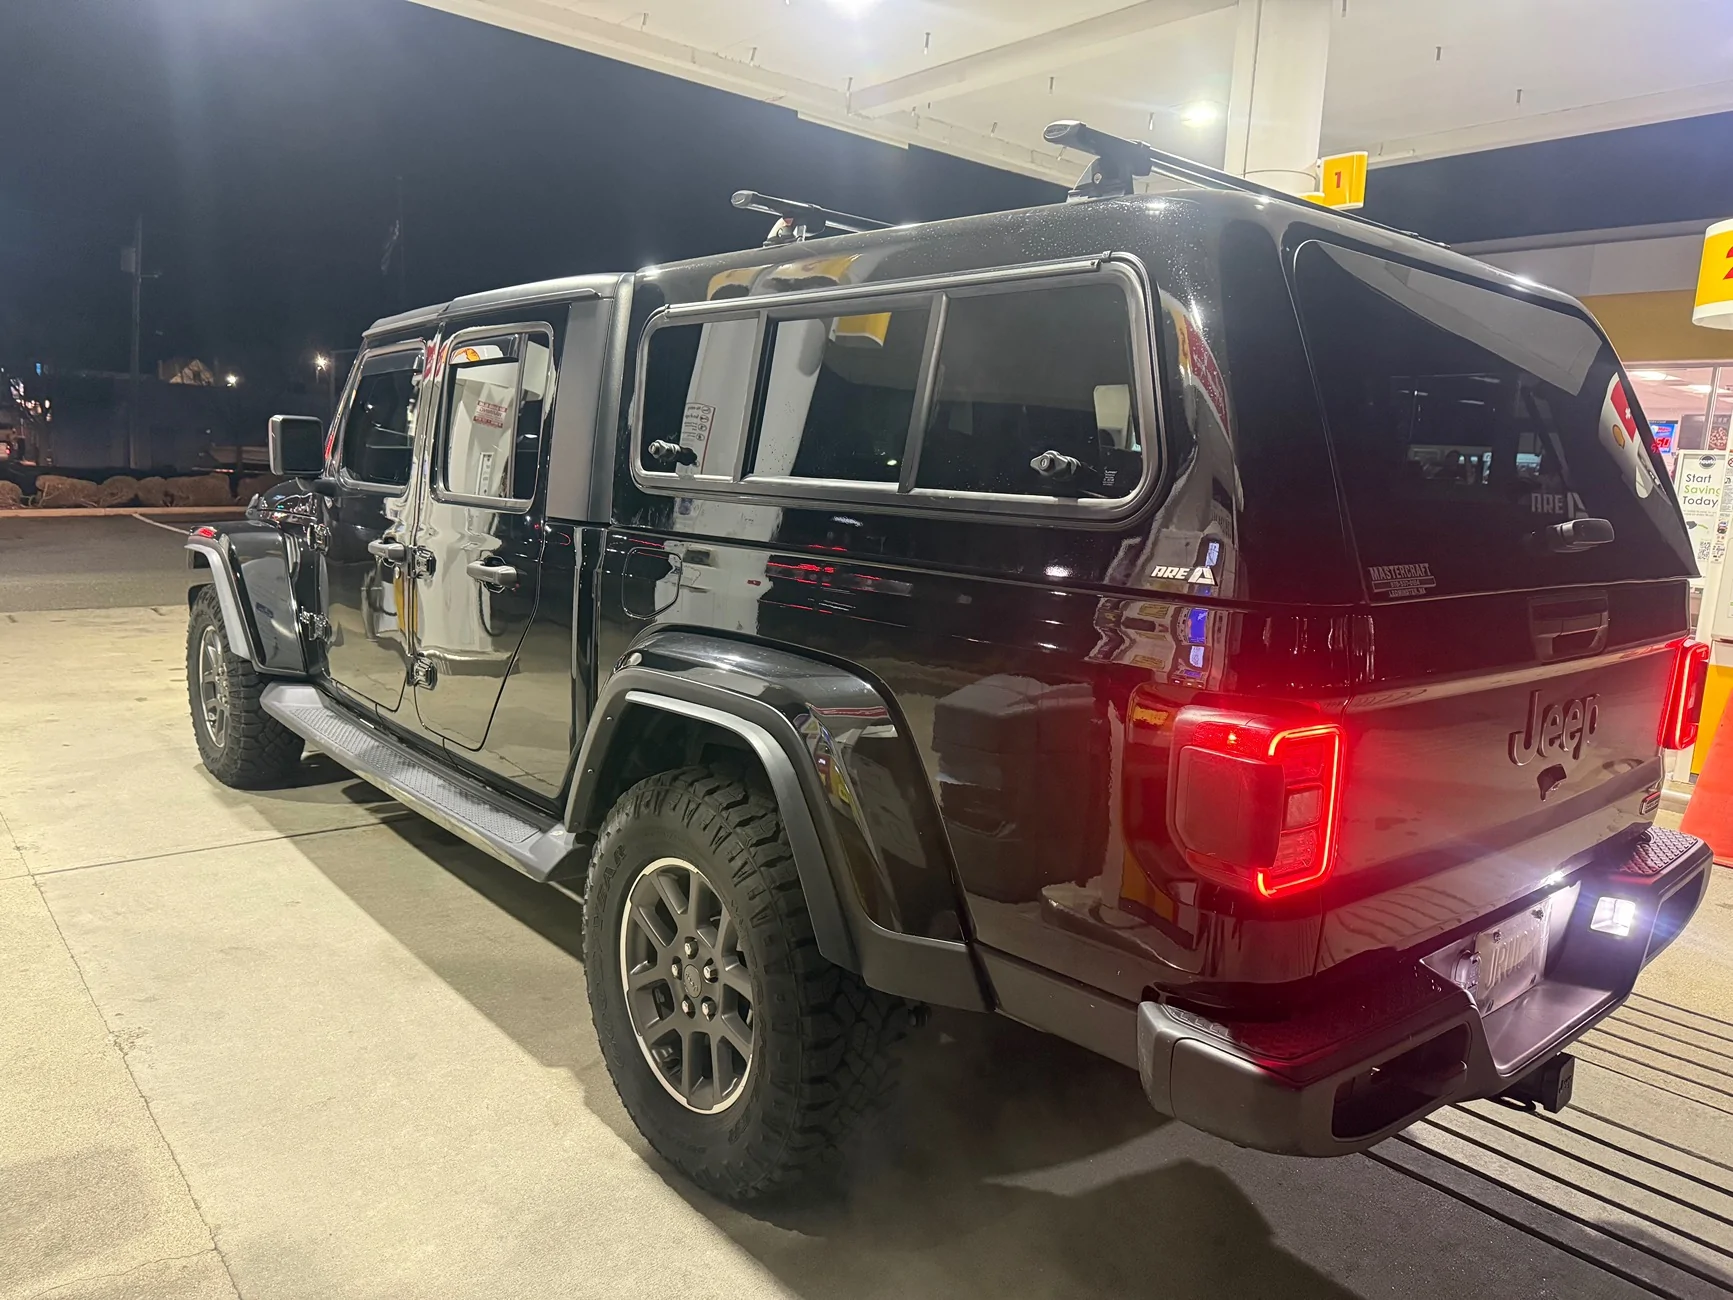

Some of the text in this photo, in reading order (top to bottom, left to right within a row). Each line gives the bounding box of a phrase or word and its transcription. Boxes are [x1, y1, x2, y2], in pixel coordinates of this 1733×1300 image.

[1334, 171, 1342, 189] 1
[1686, 473, 1711, 483] Start
[1531, 492, 1564, 514] ARE
[1683, 496, 1718, 508] Today
[1150, 565, 1190, 579] ARE
[1368, 563, 1431, 580] MASTERCRAFT
[1508, 690, 1600, 766] Jeep
